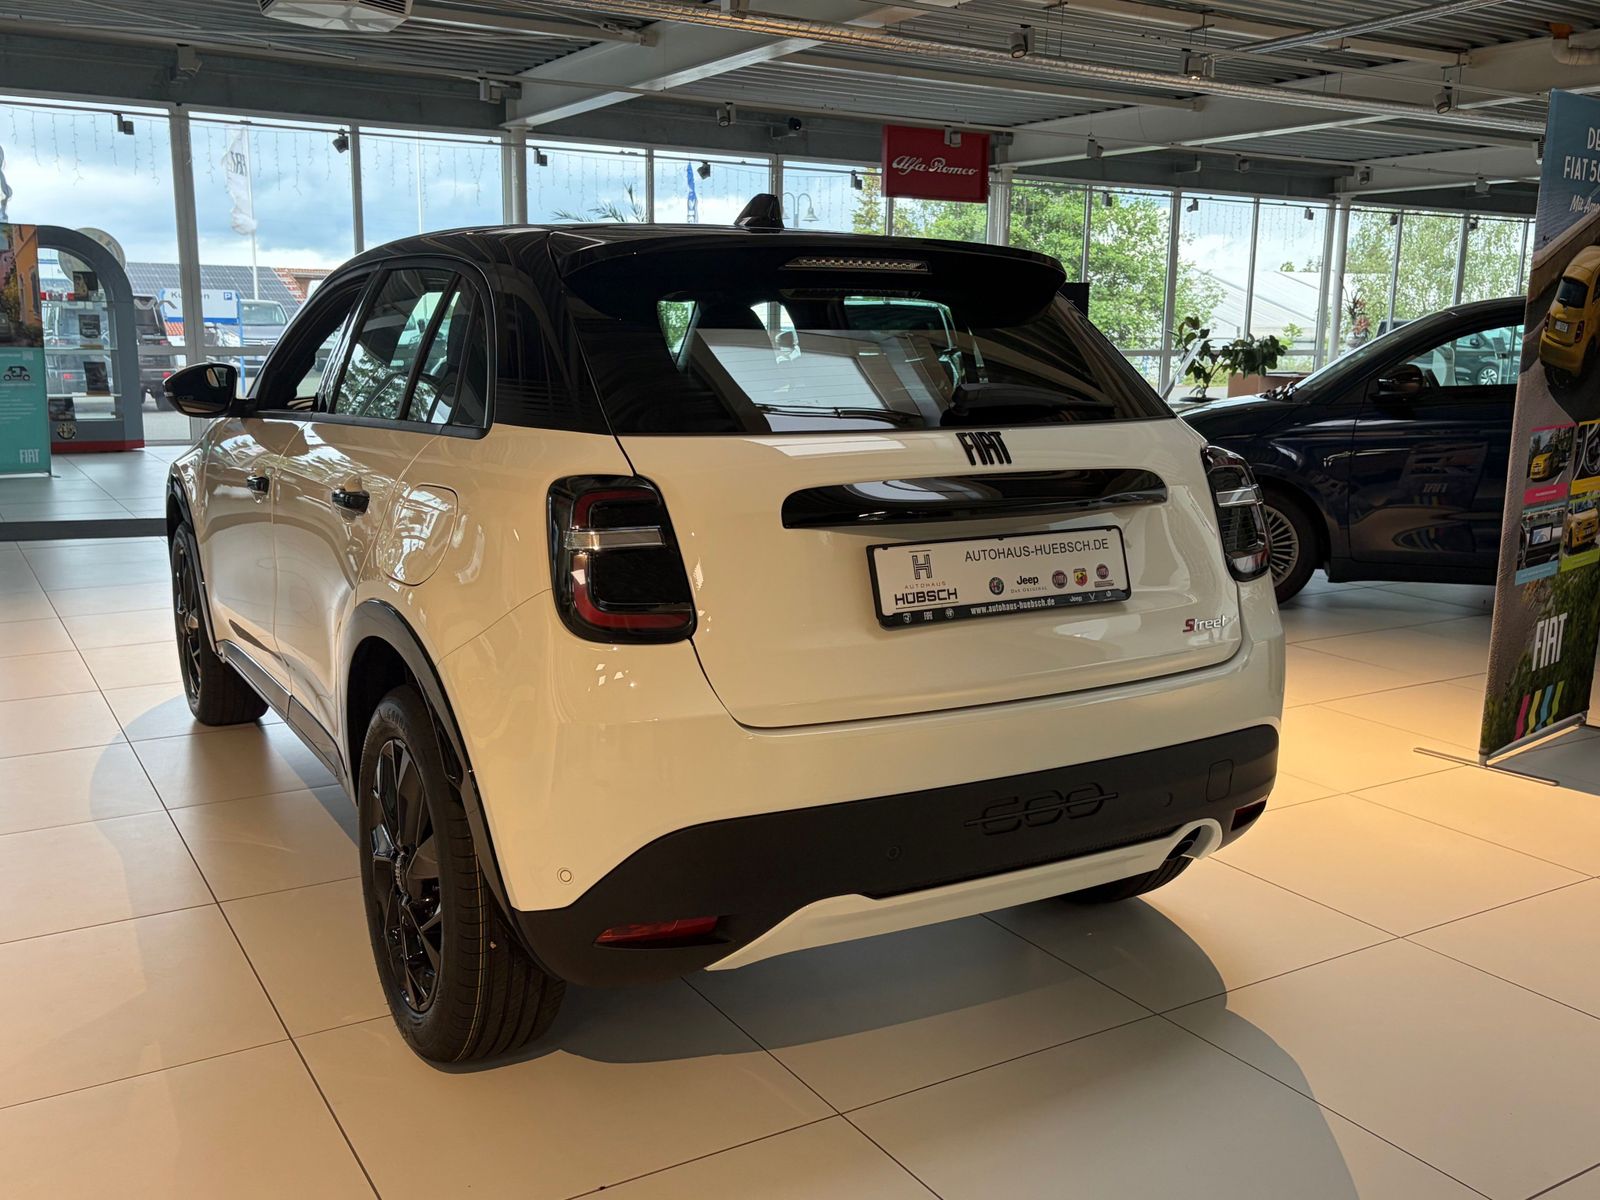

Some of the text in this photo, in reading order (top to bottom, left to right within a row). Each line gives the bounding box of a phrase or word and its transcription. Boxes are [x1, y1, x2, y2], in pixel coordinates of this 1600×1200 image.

[892, 155, 978, 176] Alfa Romeo
[1563, 155, 1588, 180] FIAT
[19, 448, 40, 463] FIAT
[955, 431, 1012, 466] FIAT
[964, 538, 1109, 562] AUTOHAUS-HUEBSCH.DE
[904, 580, 947, 590] AUTOHAUS
[1016, 575, 1039, 586] Jeep
[894, 588, 958, 606] HÜBSCH
[970, 597, 1056, 615] www.autohaus-huebsch.de
[1183, 614, 1226, 632] Street
[1532, 612, 1568, 672] FIAT
